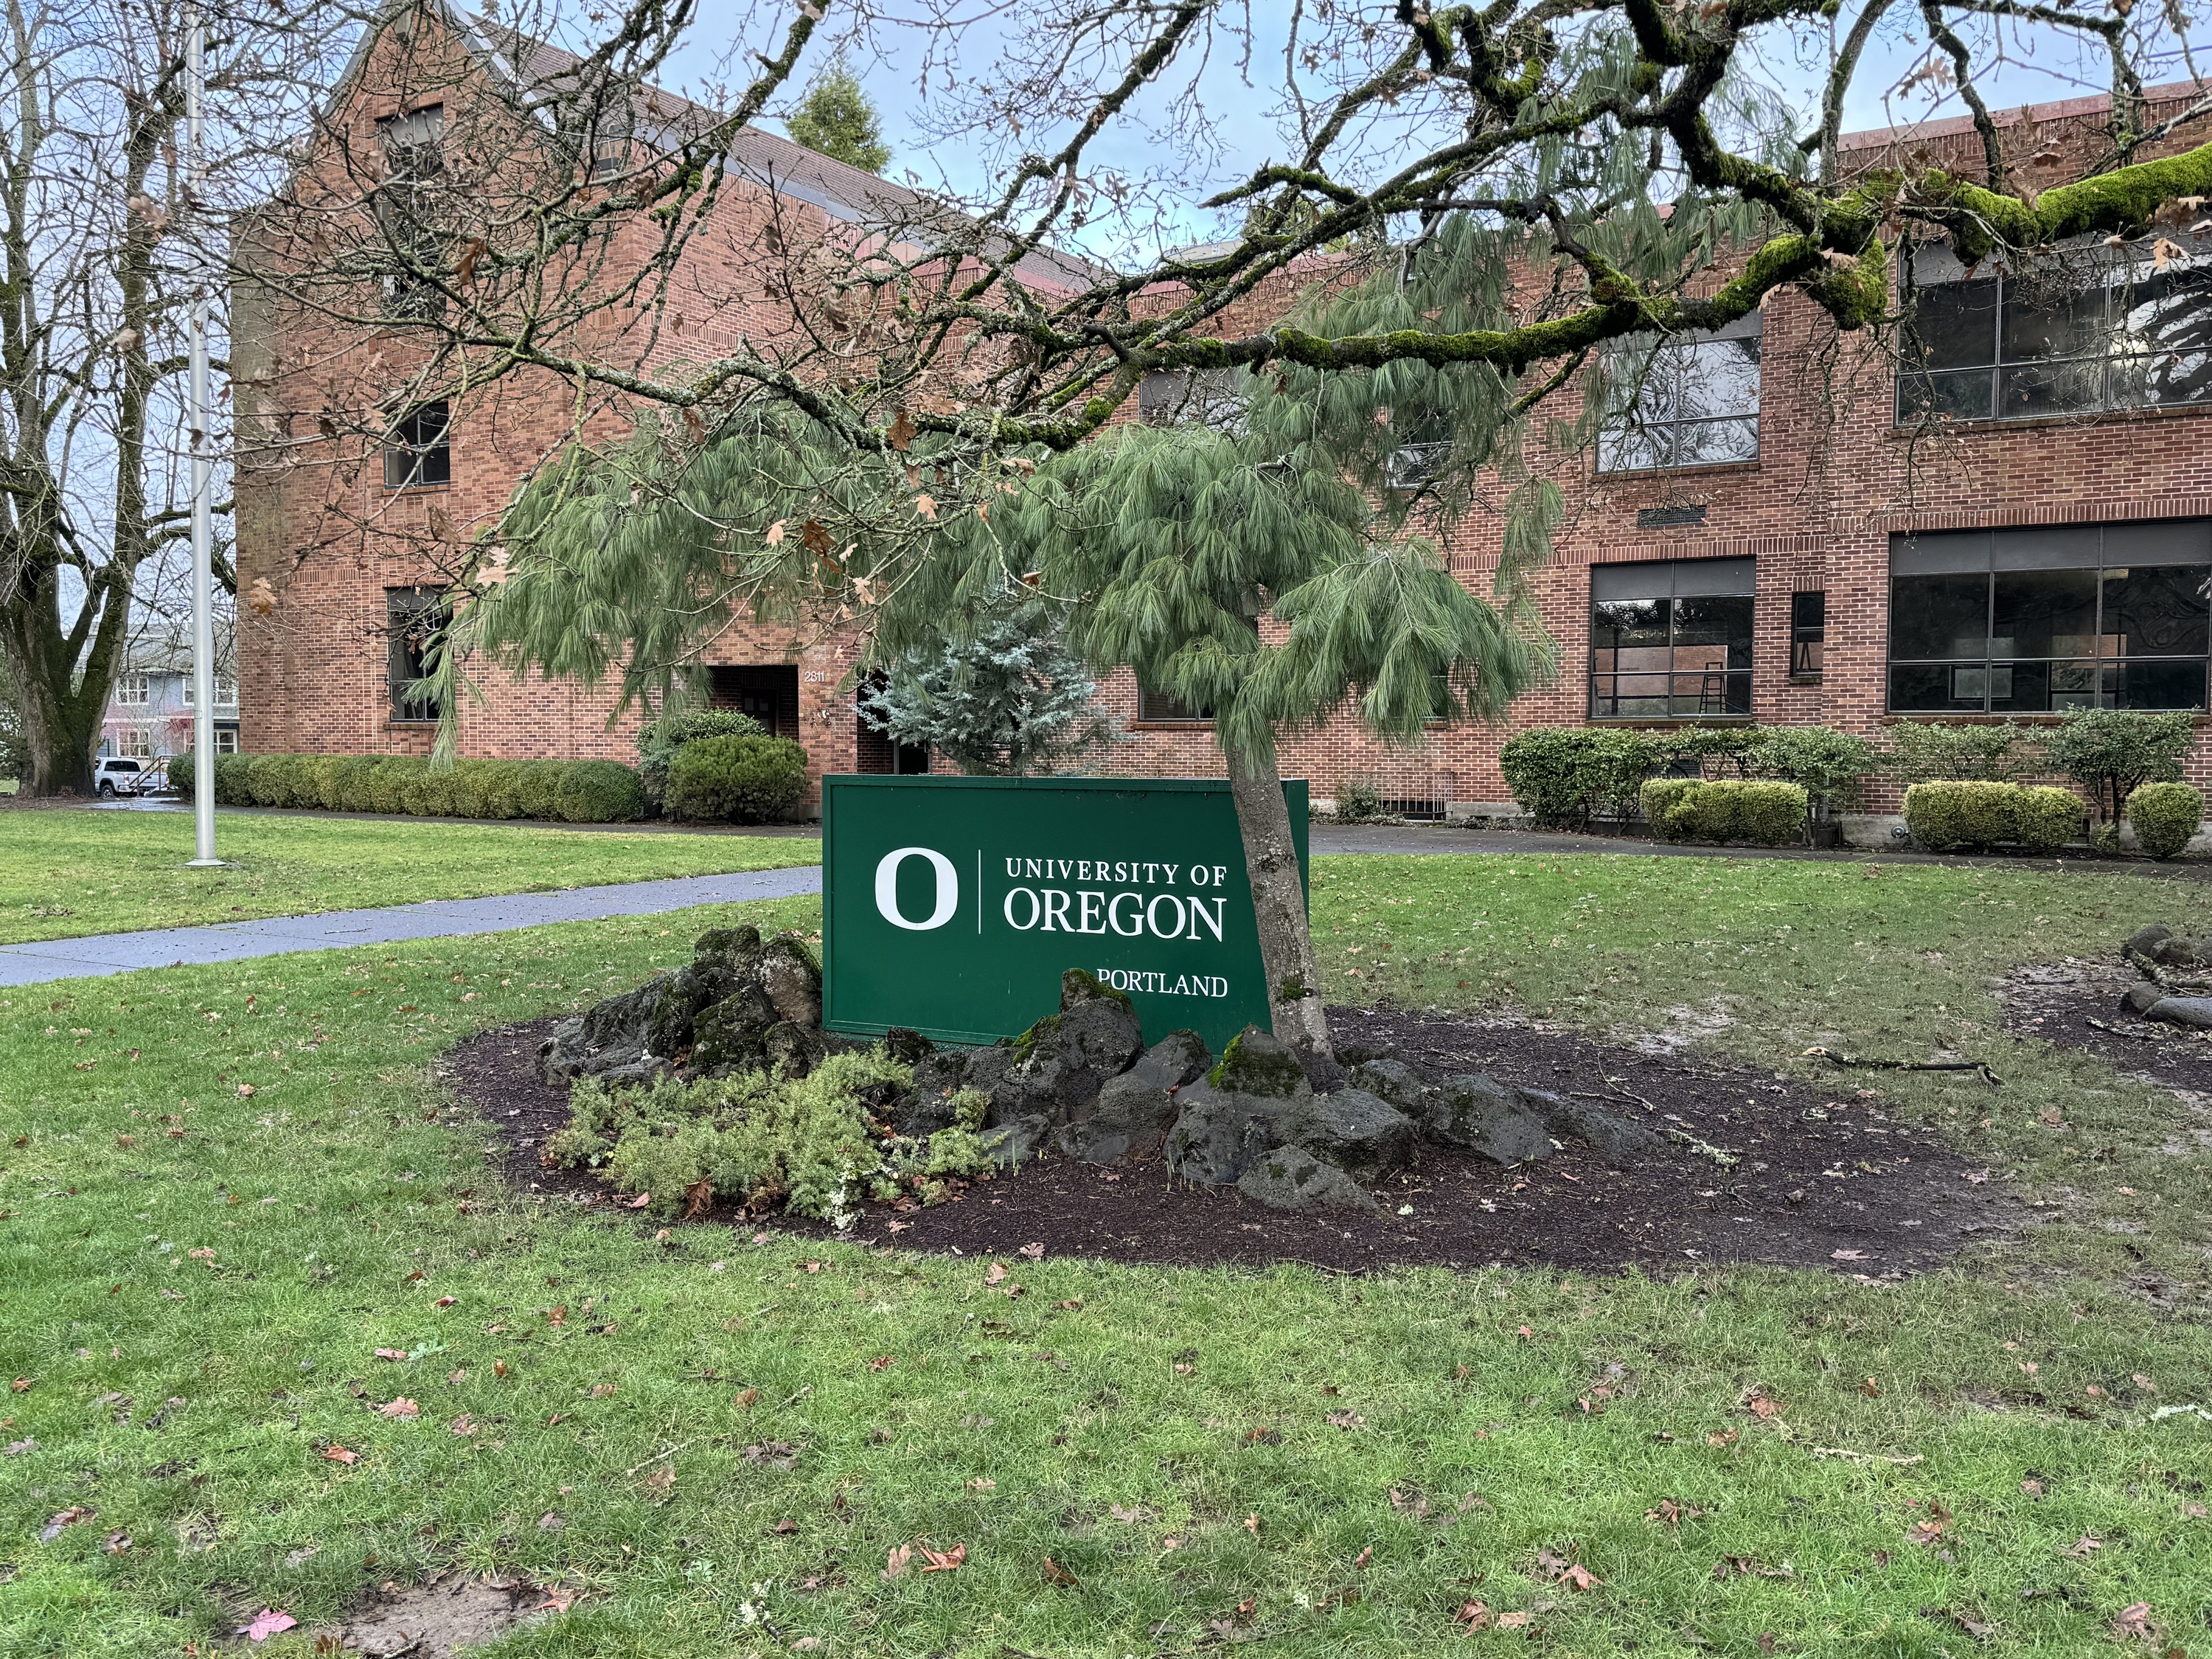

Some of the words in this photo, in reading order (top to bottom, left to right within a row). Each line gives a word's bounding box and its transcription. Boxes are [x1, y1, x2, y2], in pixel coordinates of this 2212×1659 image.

[804, 670, 824, 682] 2811
[1005, 858, 1179, 885] UNIVERSITY
[1190, 864, 1228, 886] OF
[874, 846, 959, 931] O
[1004, 887, 1228, 942] OREGON
[1096, 968, 1228, 998] PORTLAND
